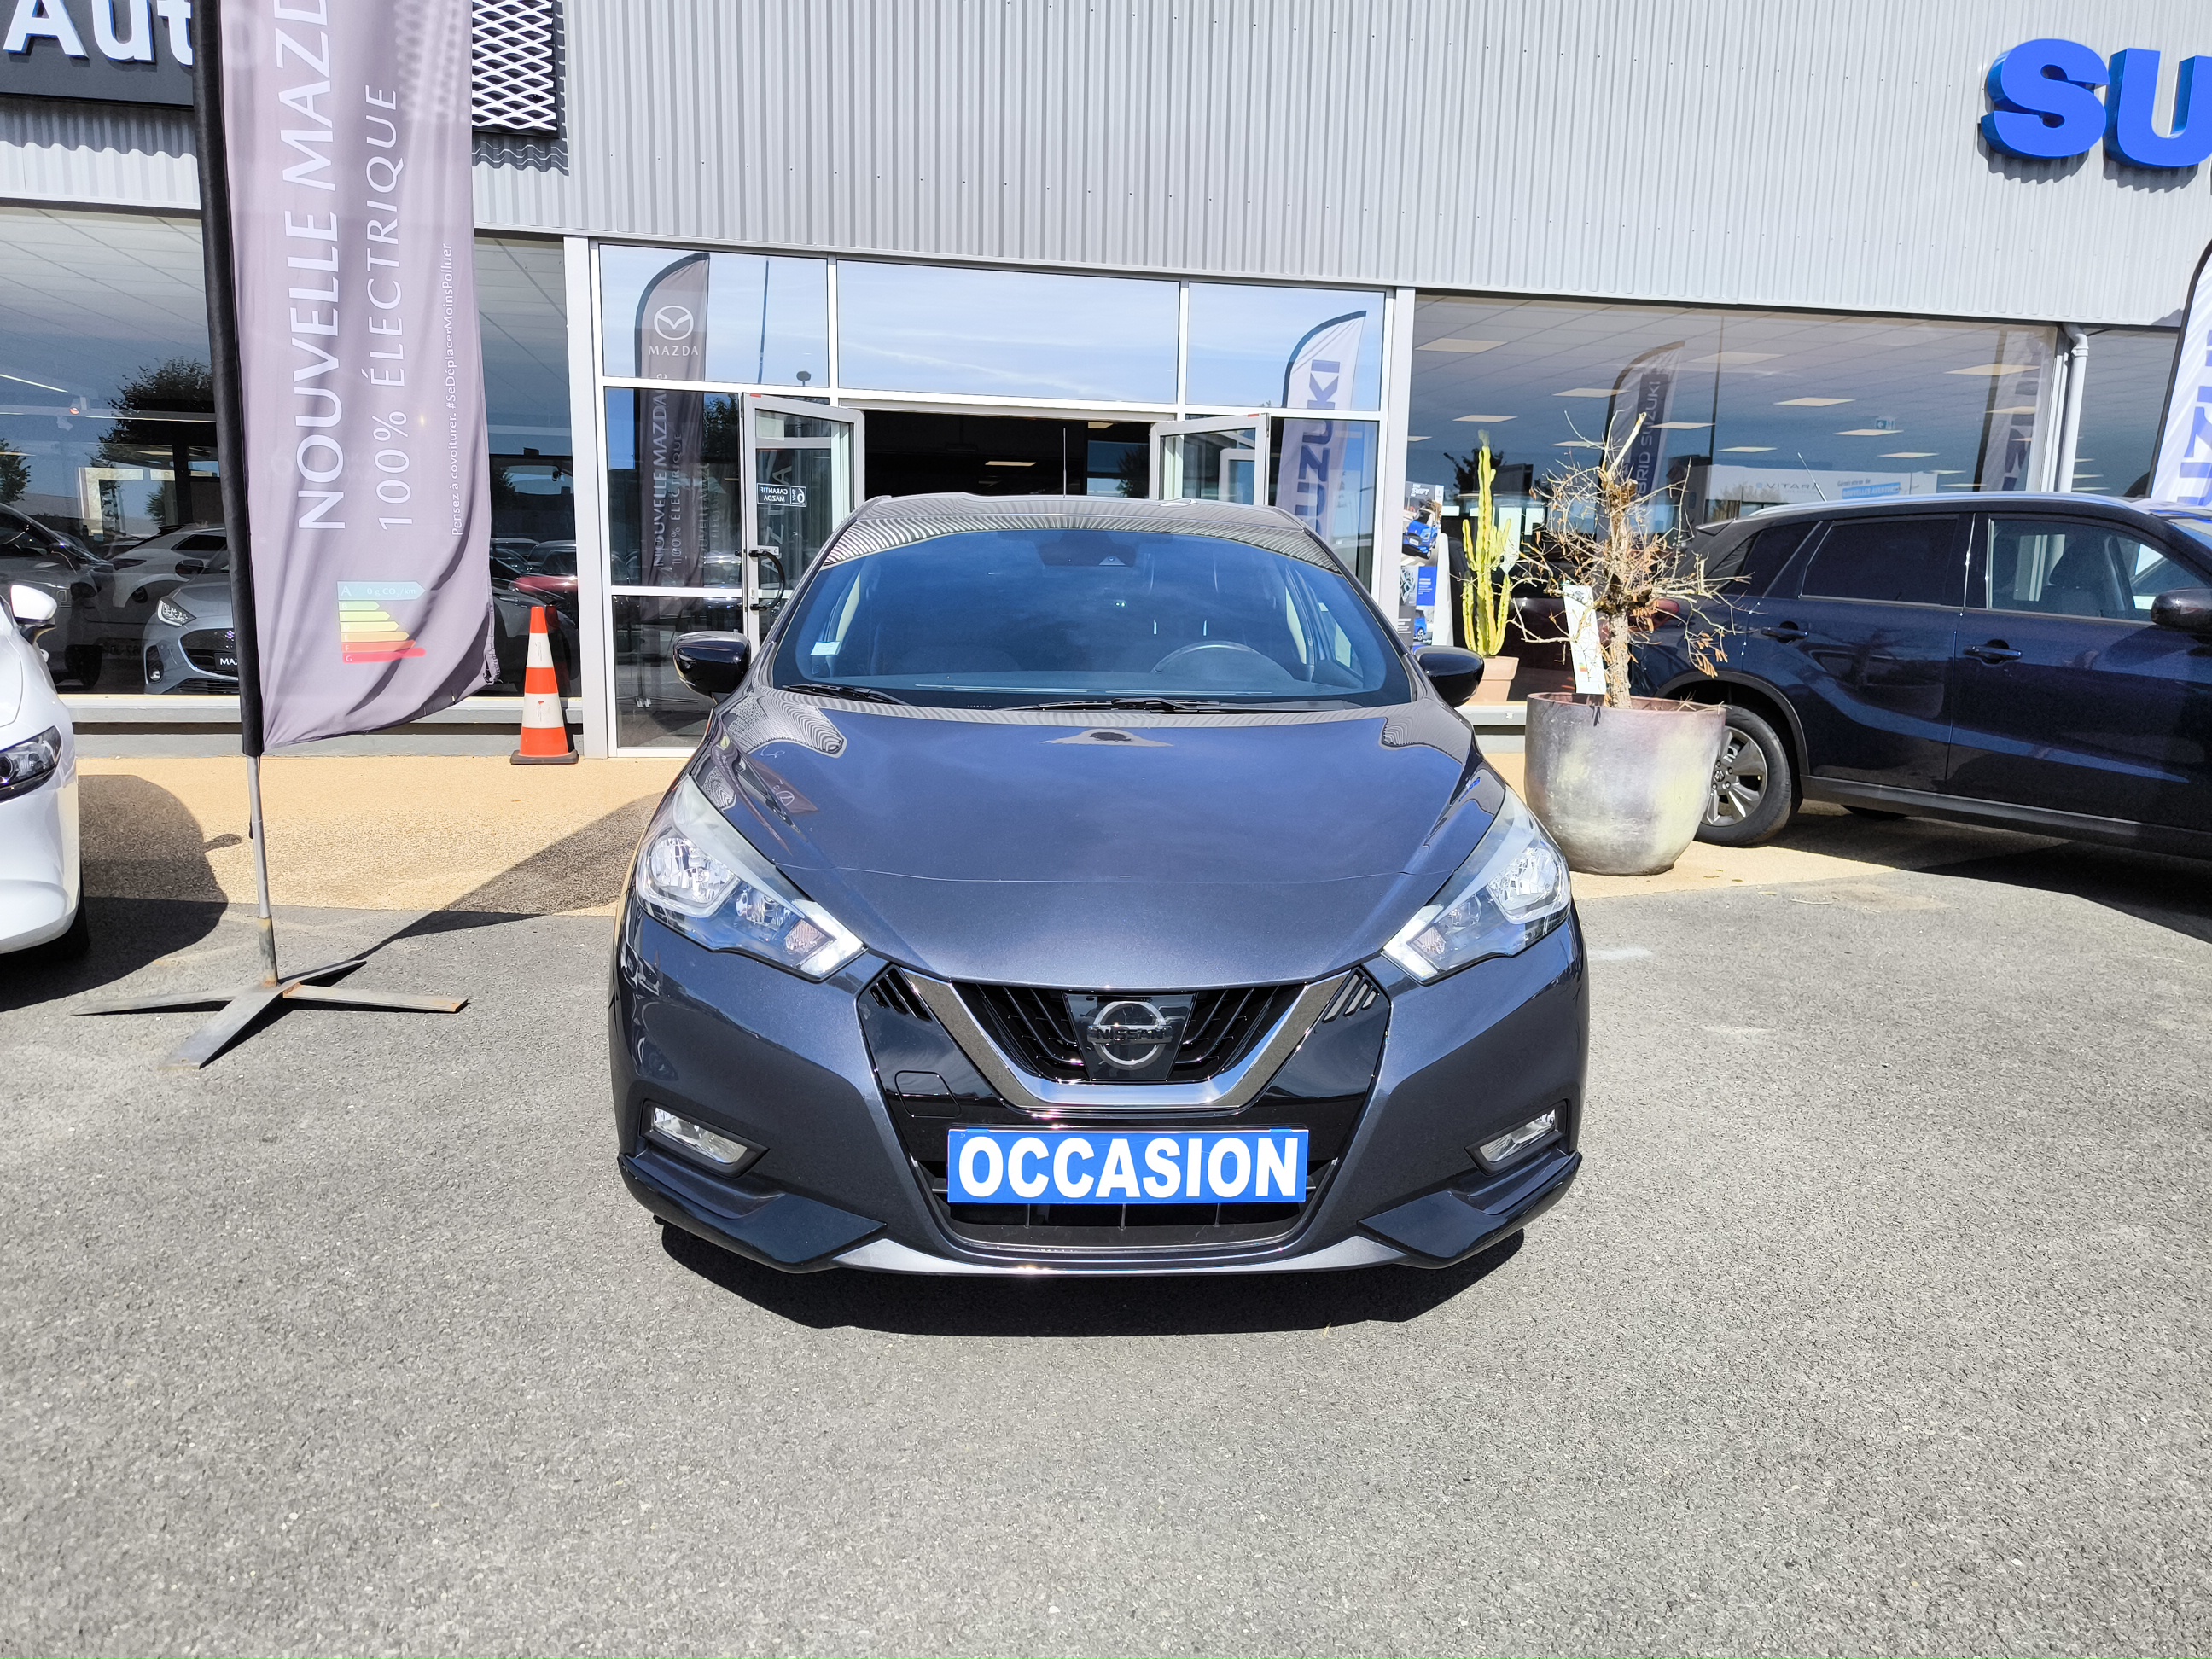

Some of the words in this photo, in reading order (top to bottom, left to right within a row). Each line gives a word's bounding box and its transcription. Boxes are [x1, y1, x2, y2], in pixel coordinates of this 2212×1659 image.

[1981, 38, 2212, 168] SU
[361, 84, 405, 387] ÉLECTRIQUE
[440, 243, 457, 409] #SeDéplacerMoinsPolluer
[649, 345, 699, 356] MAZDA
[284, 210, 346, 529] NOUVELLE
[372, 410, 413, 530] 100%
[447, 412, 458, 480] covoiturer.
[652, 393, 667, 468] MAZDA
[1293, 359, 1341, 539] UZUKI
[449, 492, 463, 536] Pensez
[653, 470, 667, 567] NOUVELLE
[341, 585, 352, 597] A
[1095, 1028, 1165, 1040] NISSAN
[958, 1136, 1299, 1198] OCCASION
